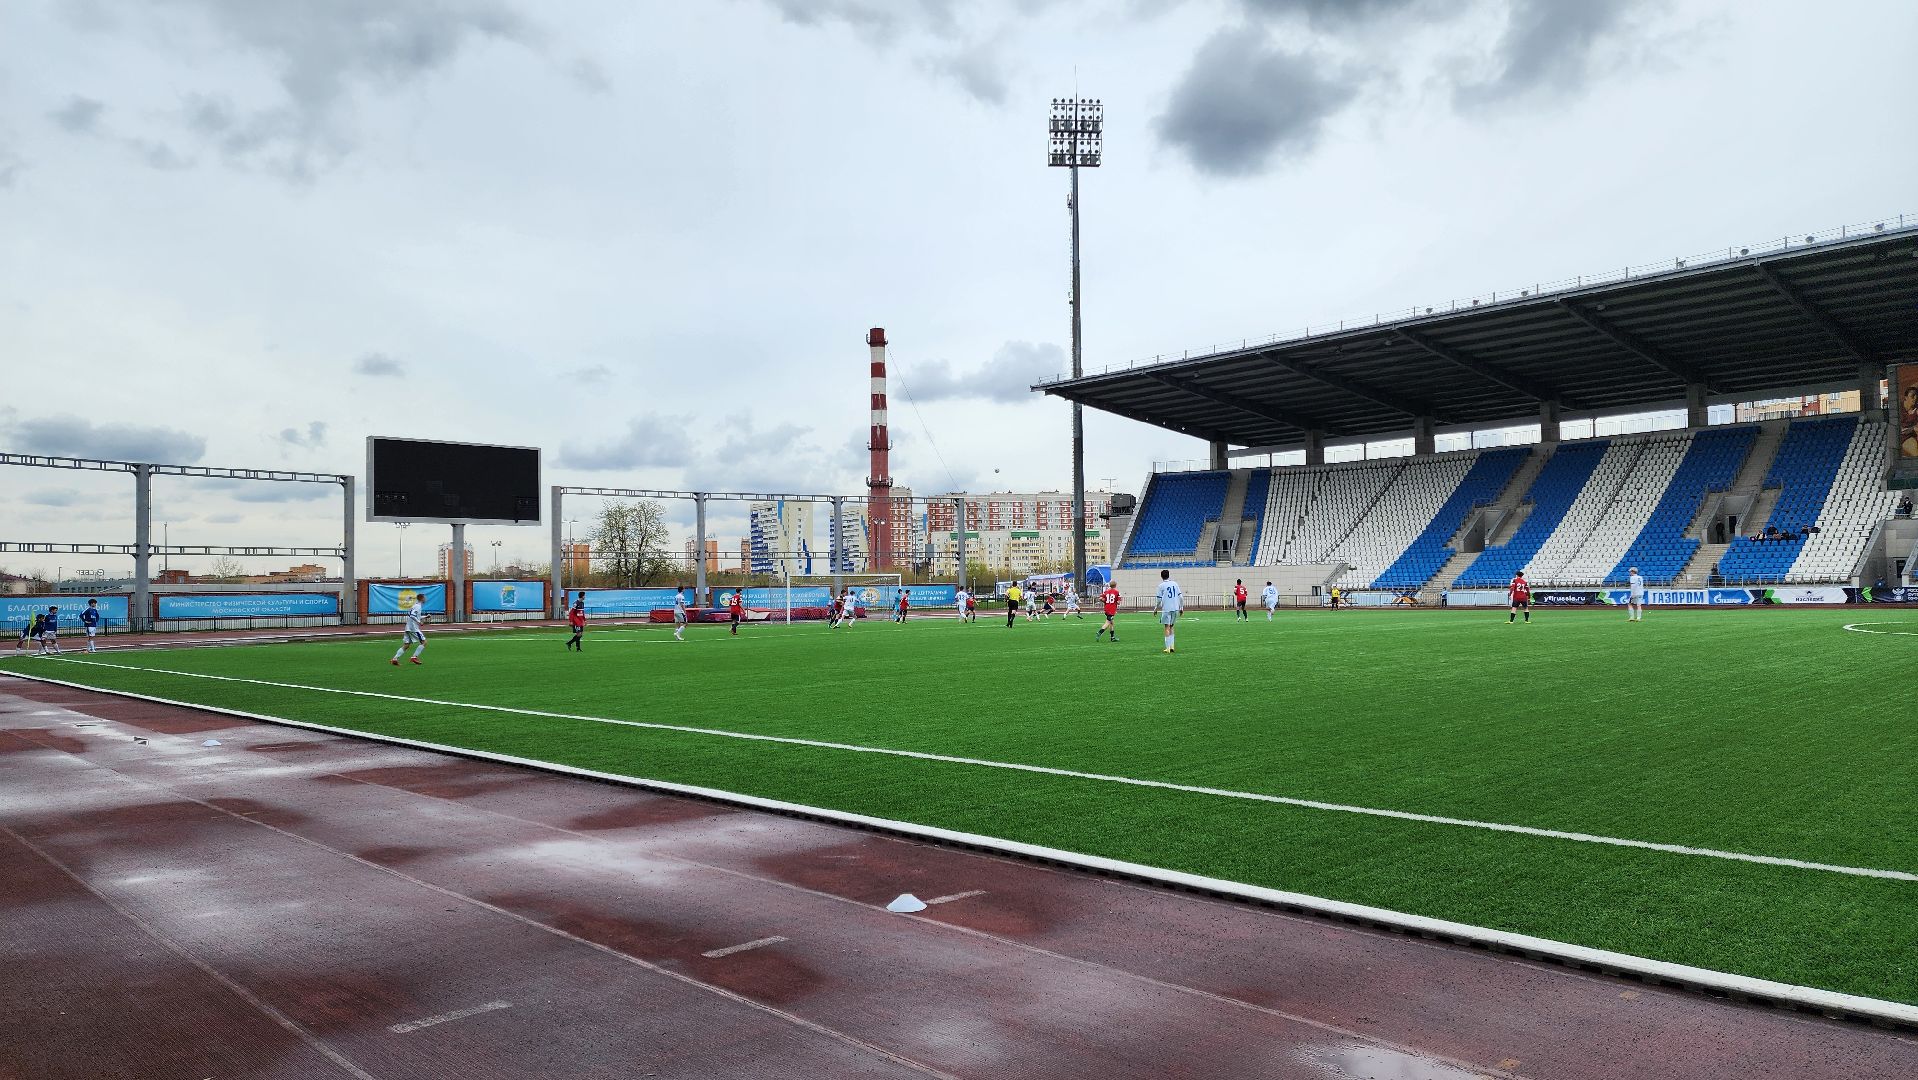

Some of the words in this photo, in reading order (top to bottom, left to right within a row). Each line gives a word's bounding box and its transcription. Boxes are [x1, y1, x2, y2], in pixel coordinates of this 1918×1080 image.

[1167, 586, 1176, 598] 31
[1652, 591, 1704, 604] ГАЗПРОМ
[1105, 593, 1115, 604] 18
